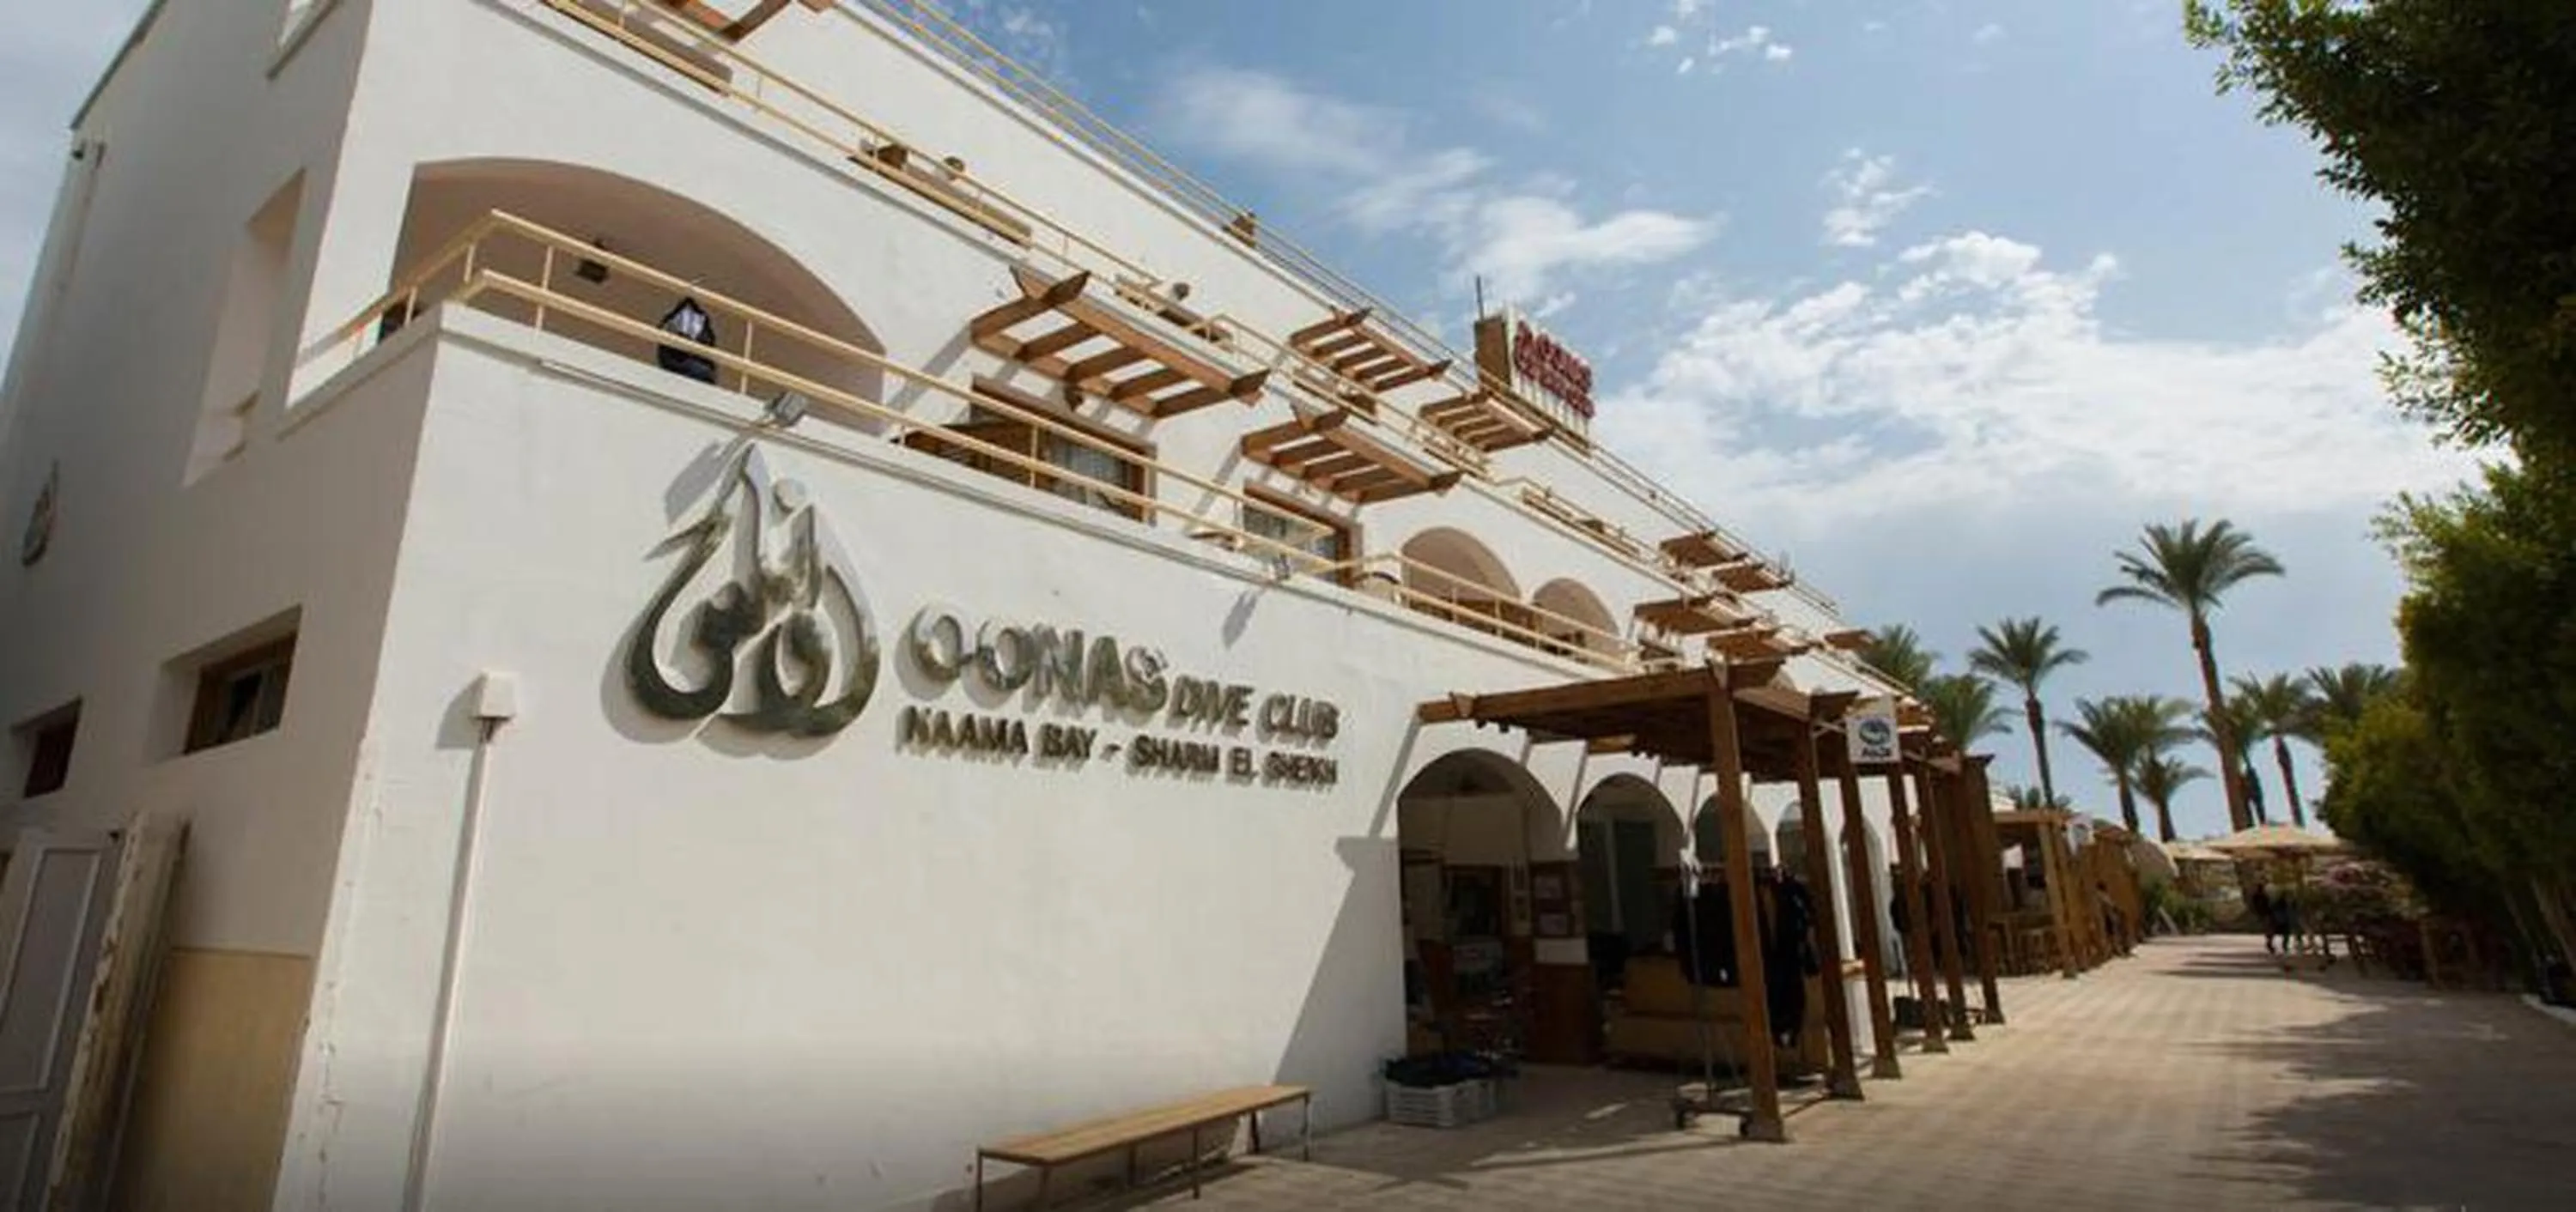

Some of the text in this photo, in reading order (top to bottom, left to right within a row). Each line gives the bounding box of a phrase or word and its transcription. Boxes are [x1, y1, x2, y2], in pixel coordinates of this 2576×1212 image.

[907, 603, 1340, 741] OONAS DIVE CLUB
[898, 705, 1028, 756] NAAMA
[1037, 722, 1097, 759] BAY
[1130, 734, 1219, 773] SHARM
[1226, 746, 1258, 777] EL
